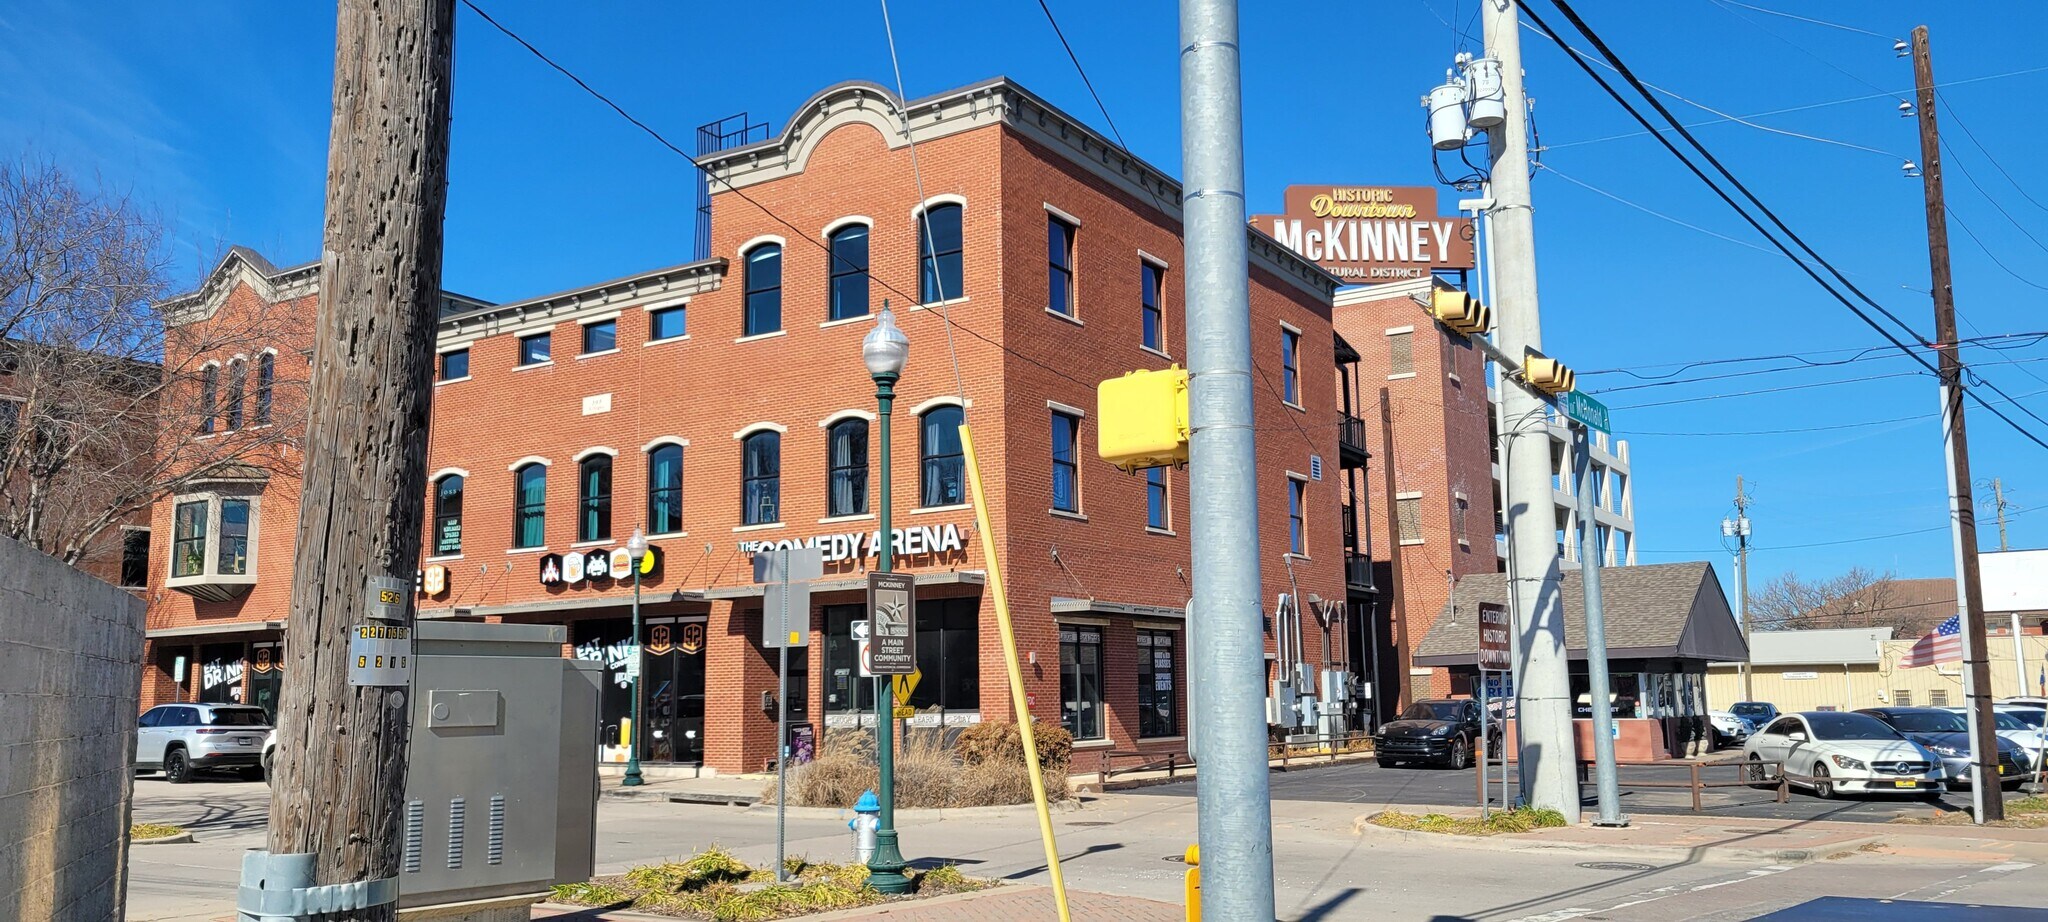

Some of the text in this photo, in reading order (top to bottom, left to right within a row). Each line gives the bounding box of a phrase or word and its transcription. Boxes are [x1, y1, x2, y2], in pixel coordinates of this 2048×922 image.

[1332, 188, 1393, 202] HISTORIC
[1310, 194, 1416, 218] Downtown
[1274, 219, 1454, 262] McKINNEY
[1324, 267, 1422, 278] TURAL DISTRICT
[740, 541, 758, 552] THE
[867, 524, 962, 558] ARENA
[877, 581, 906, 589] MCKINNEY
[380, 590, 400, 604] 526
[1482, 609, 1508, 625] ENTERING
[1483, 629, 1508, 644] HISTORIC
[576, 637, 601, 658] EAT
[874, 654, 911, 662] COMMUNITY
[1480, 649, 1511, 664] DOWNTOWN
[204, 658, 221, 674] EAT
